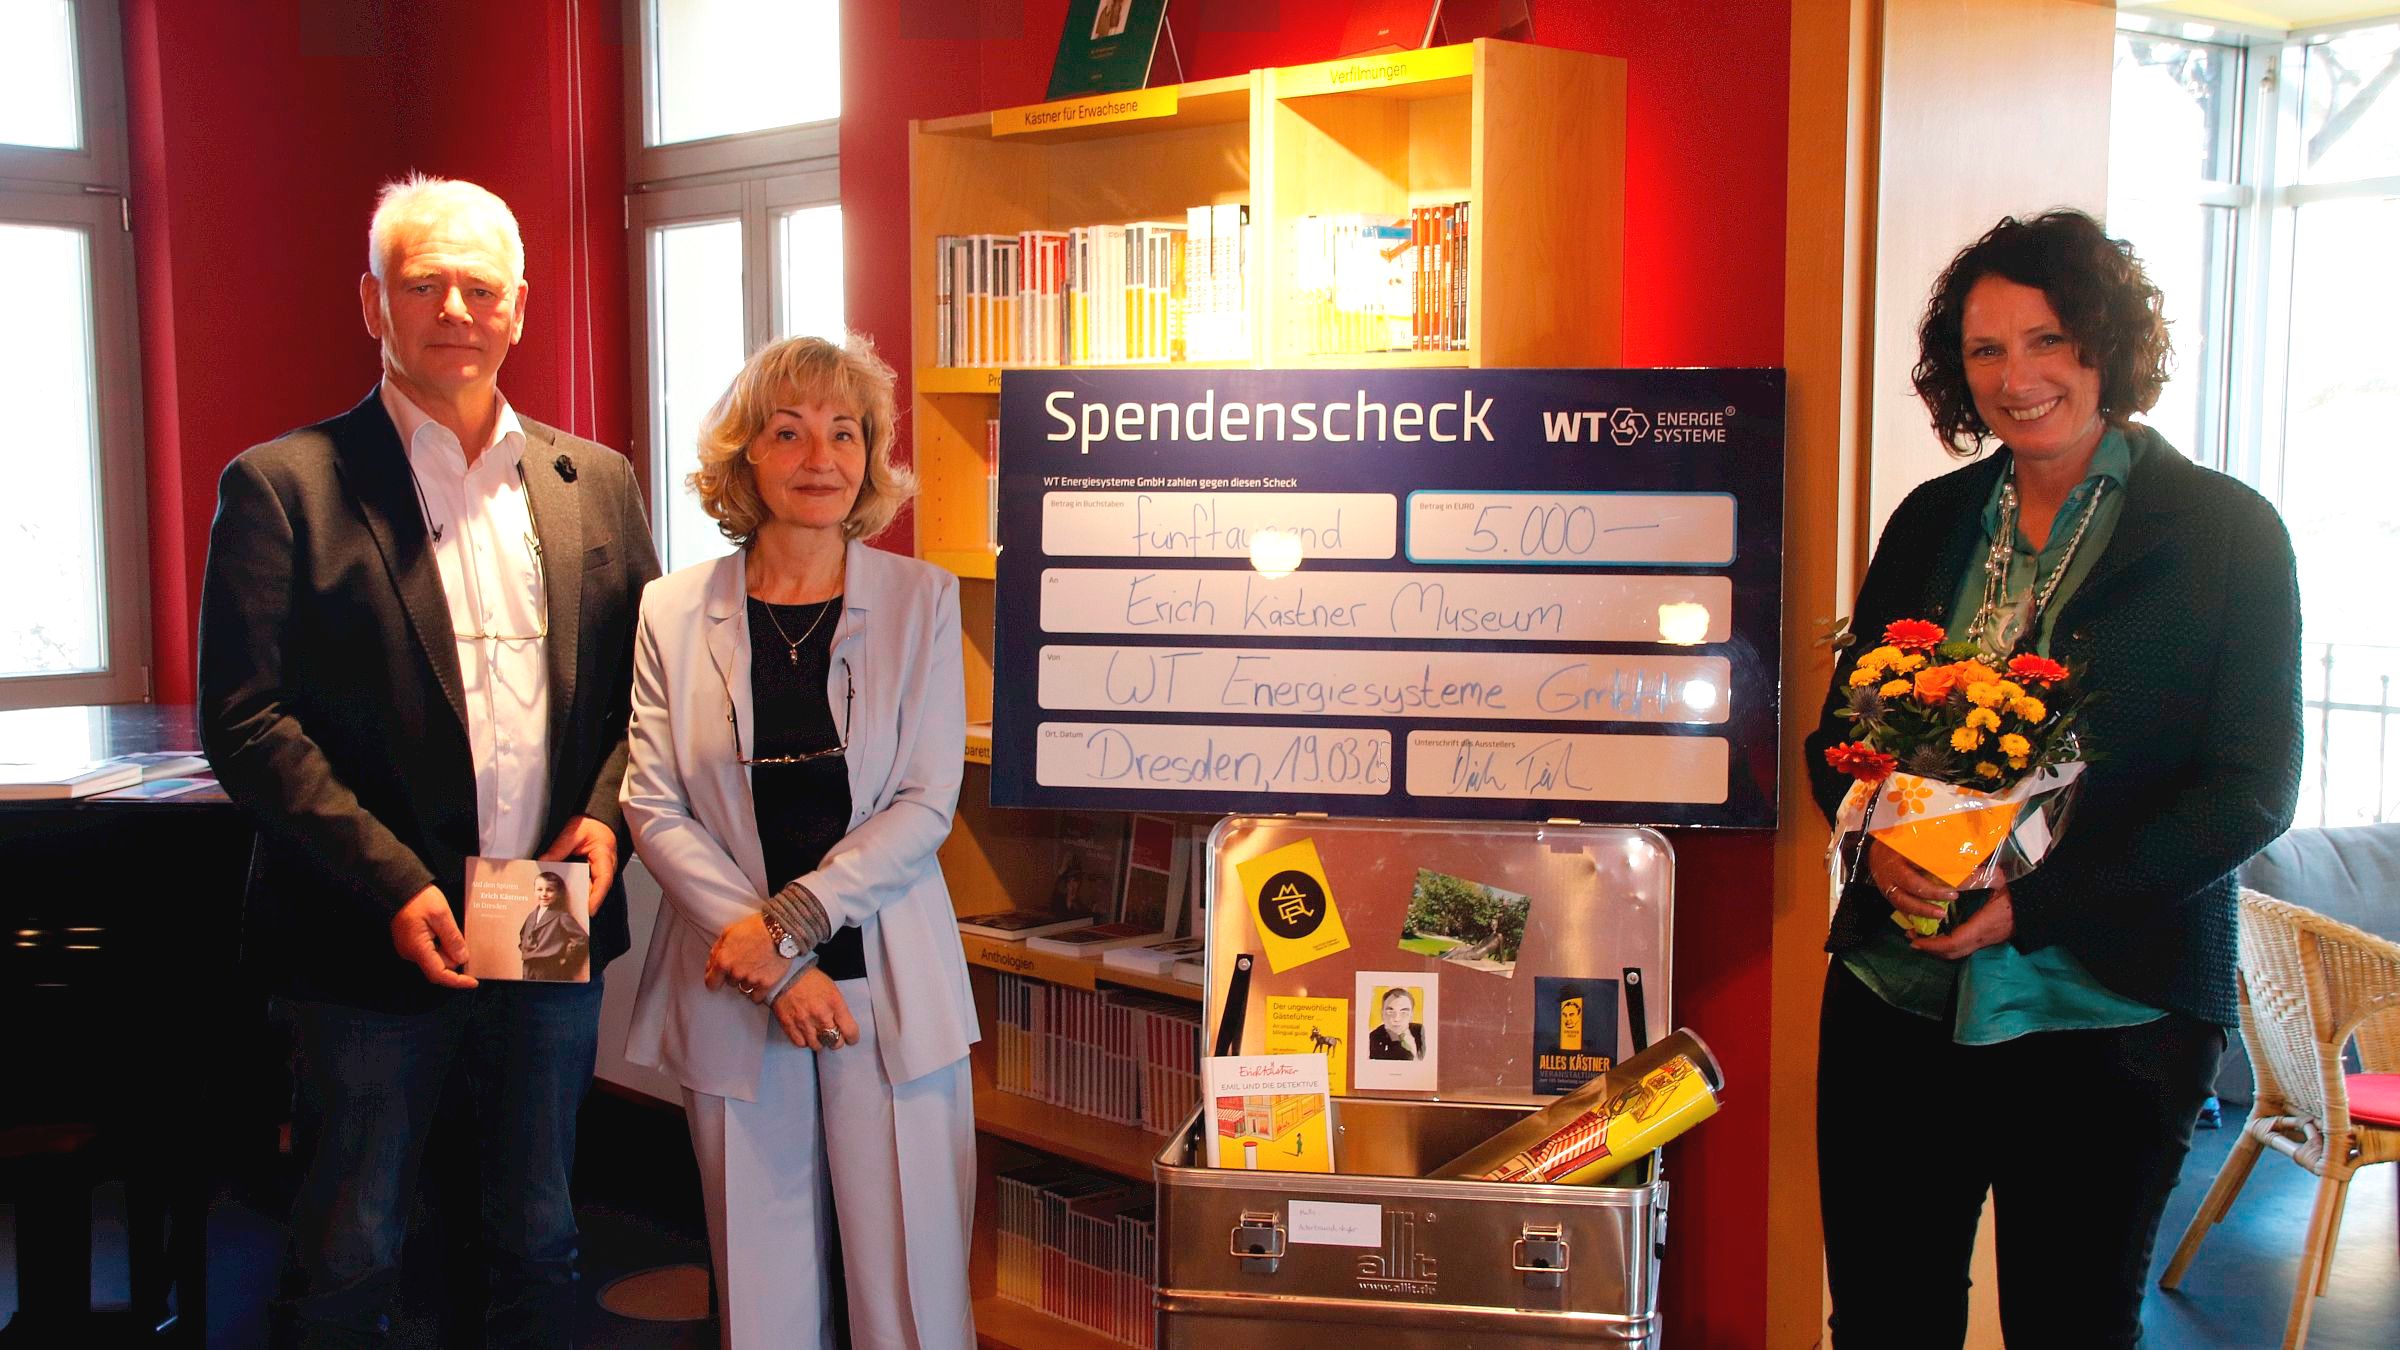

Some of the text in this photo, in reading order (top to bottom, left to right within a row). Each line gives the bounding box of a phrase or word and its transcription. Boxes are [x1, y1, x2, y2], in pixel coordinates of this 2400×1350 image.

[1329, 63, 1408, 85] Verfilmungen
[1024, 100, 1138, 126] Kästner für Erwachsene
[1045, 389, 1495, 455] Spendenscheck
[1543, 411, 1607, 443] WT
[1653, 429, 1726, 444] SYSTEME
[1043, 476, 1298, 490] WT Energiesysteme GmbH zahlen gegen diesen Scheck
[1050, 499, 1125, 509] Betrag in Buchstaben
[1419, 502, 1475, 512] Betrag in EURO
[1464, 502, 1596, 557] 5.000
[1048, 576, 1060, 584] An
[1126, 573, 1563, 633] Erich Kästner Museum
[1046, 653, 1062, 662] Von
[1104, 649, 1670, 717] WT Energiesysteme GmbH
[1059, 730, 1084, 739] Datum
[1414, 738, 1460, 748] Unterschrift
[1474, 740, 1516, 749] Ausstellers
[980, 948, 1035, 970] Anthologien
[1273, 1002, 1285, 1011] Der
[1272, 1012, 1315, 1021] Gästeführer
[1540, 1054, 1610, 1072] ALLES KÄSTNER
[1221, 1080, 1319, 1091] EMIL UND DIE DETEKTIVE
[1358, 1282, 1437, 1296] www.allit.de
